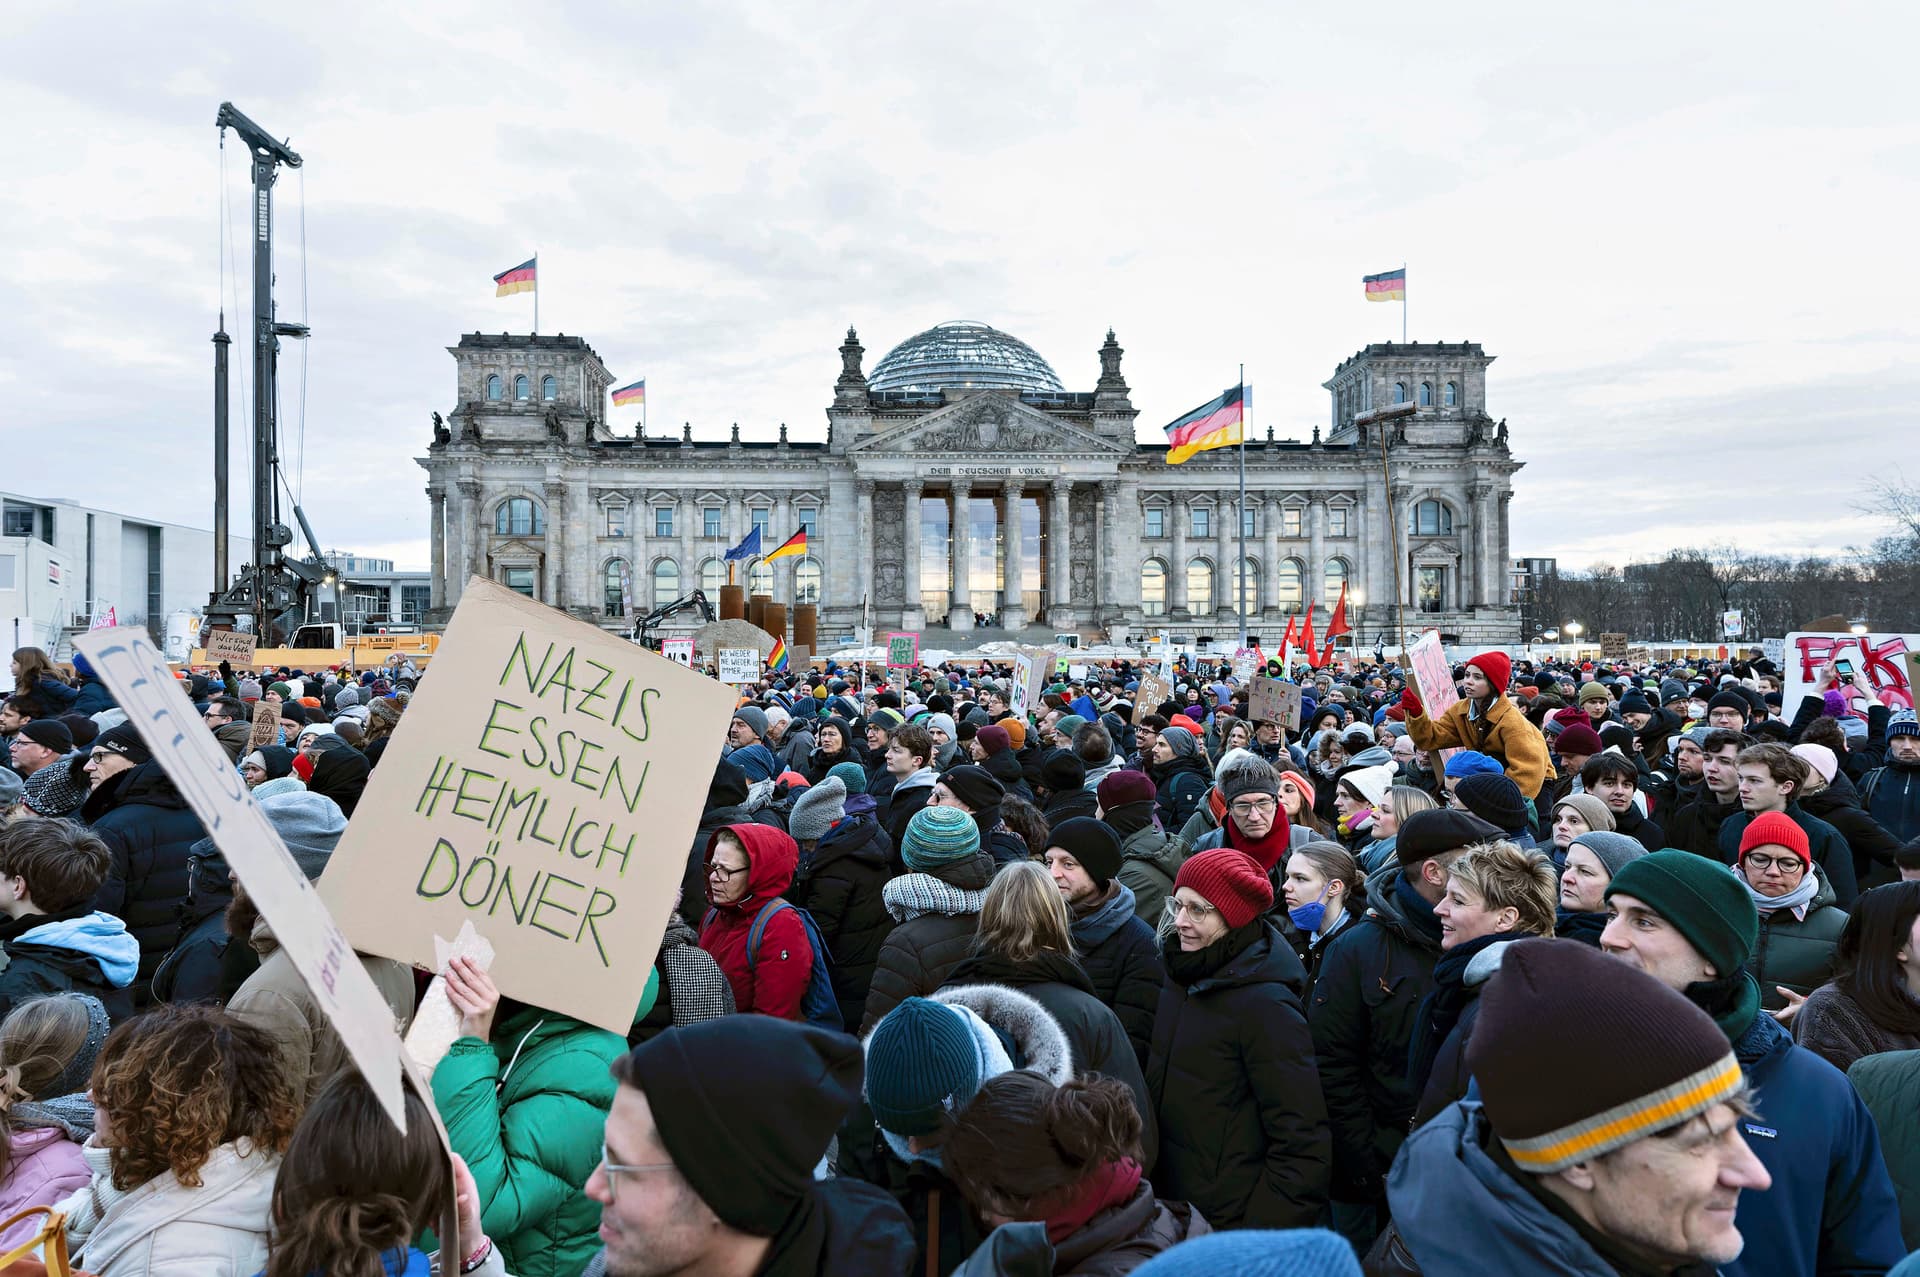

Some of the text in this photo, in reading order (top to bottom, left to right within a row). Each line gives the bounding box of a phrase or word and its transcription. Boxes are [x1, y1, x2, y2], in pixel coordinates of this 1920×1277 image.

[259, 190, 268, 241] LIEBHERR
[930, 467, 1047, 475] DEM DEUTSCHEN VOLKE
[498, 630, 661, 743] NAZIS
[731, 658, 751, 666] WIEDER
[1141, 675, 1159, 694] Kein
[478, 699, 651, 815] ESSEN
[415, 756, 638, 878] HEIMLICH
[416, 837, 618, 968] DÖNER
